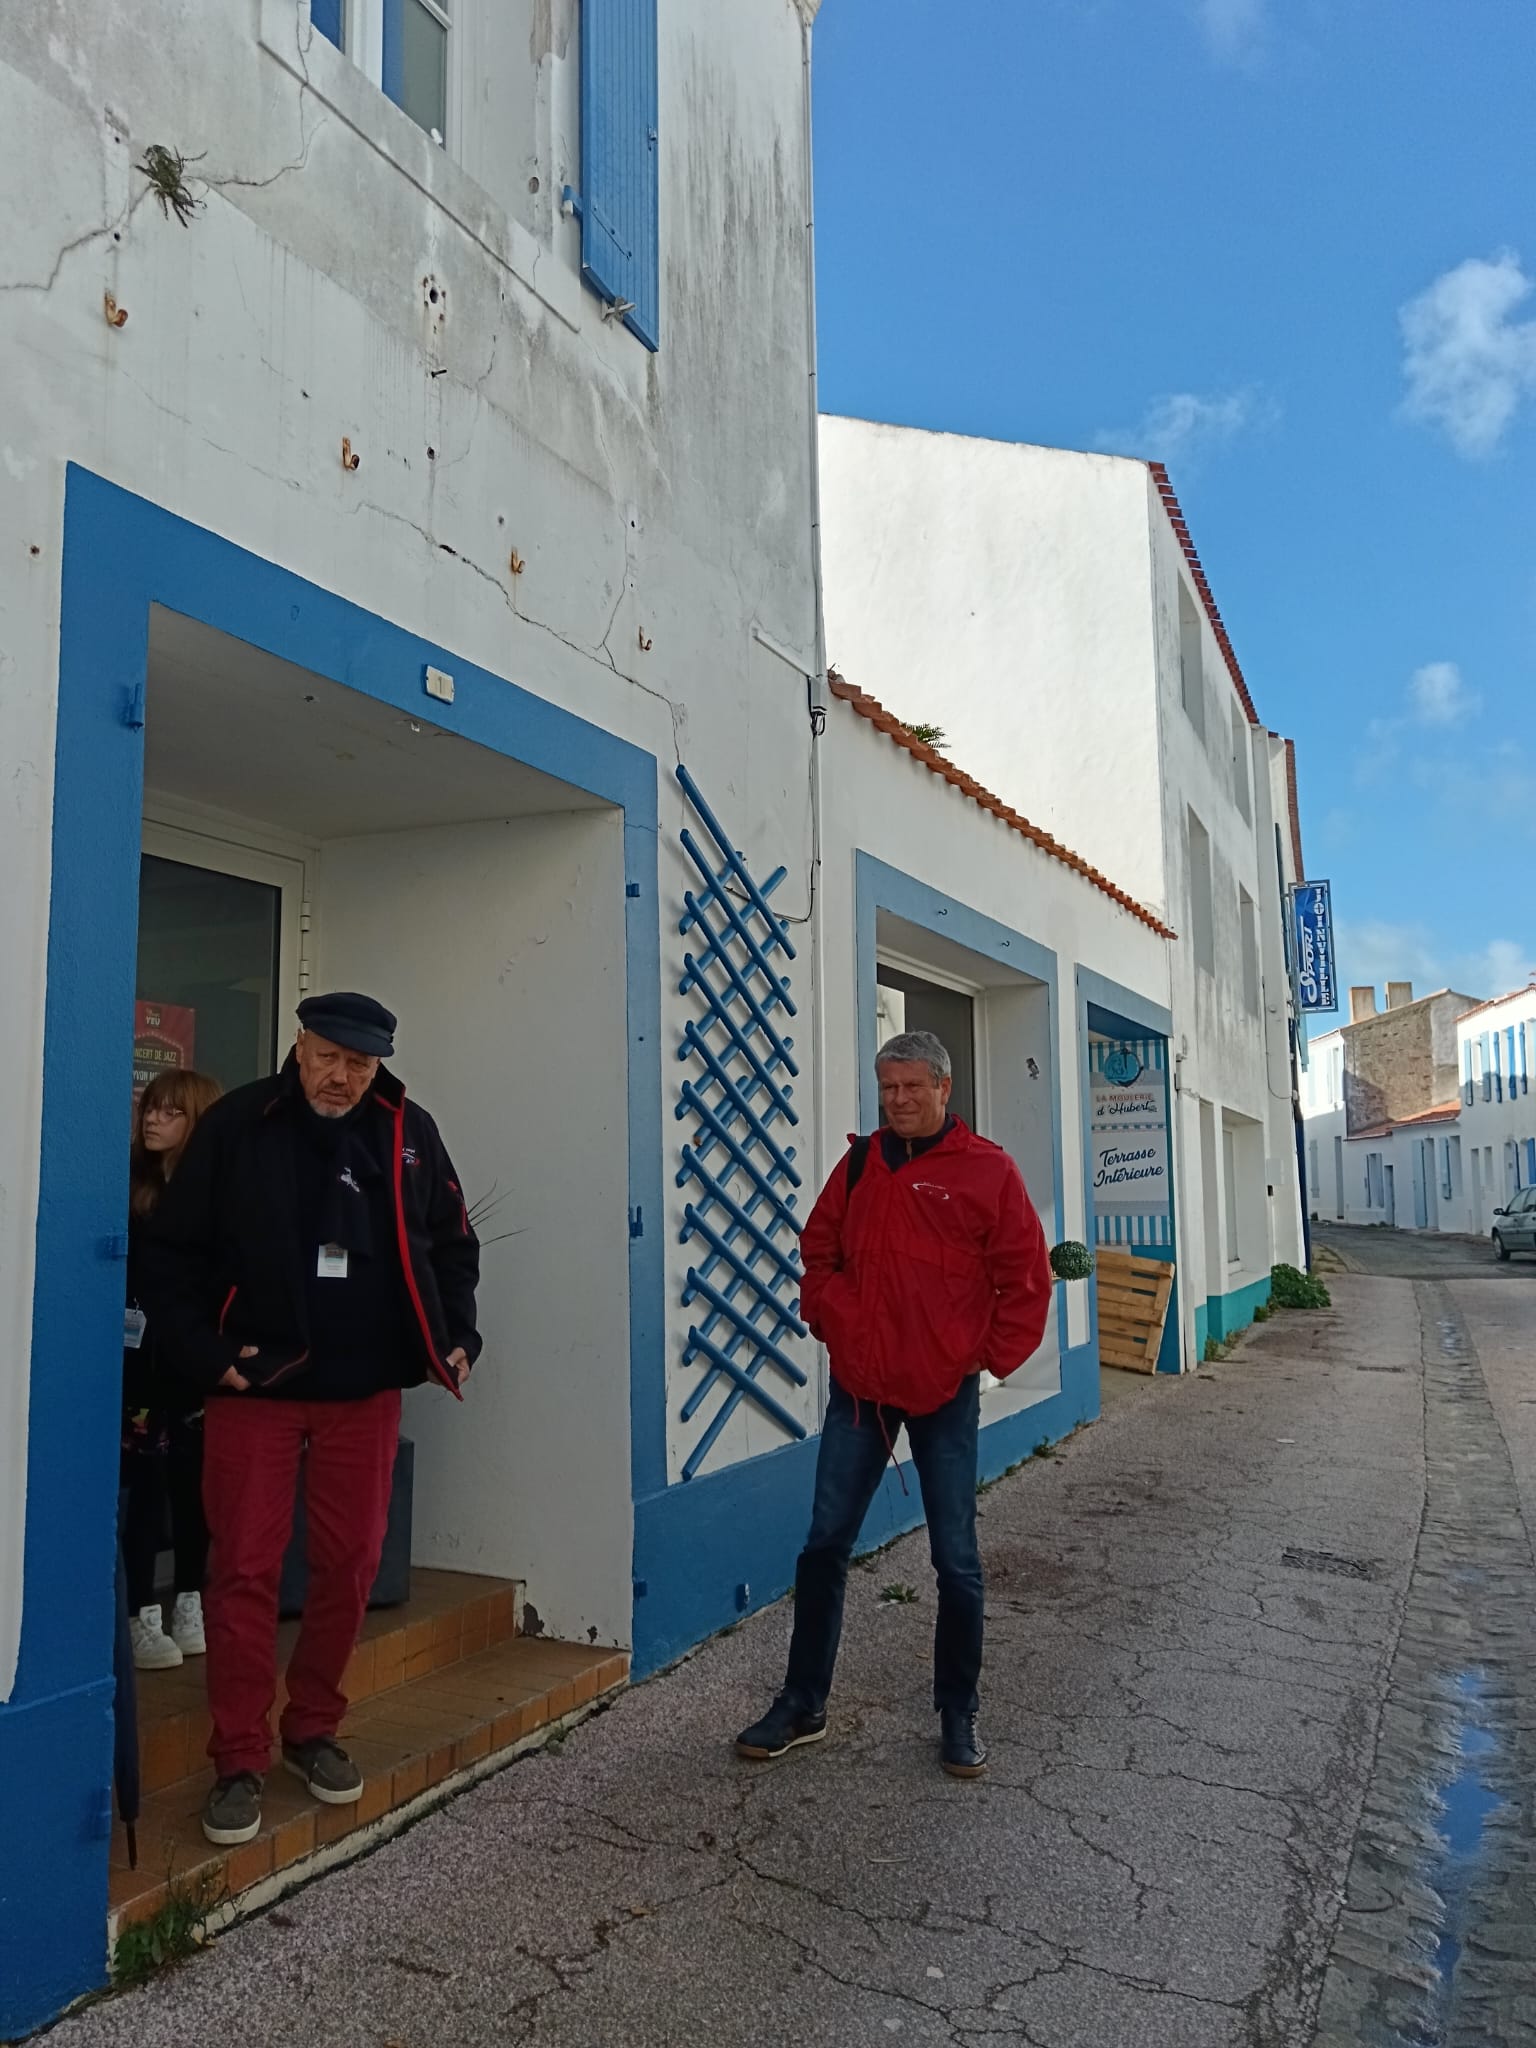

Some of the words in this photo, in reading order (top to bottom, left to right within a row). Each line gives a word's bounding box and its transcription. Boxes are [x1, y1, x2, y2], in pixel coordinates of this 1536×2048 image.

[1314, 888, 1332, 1006] JOINVILLE
[134, 1047, 152, 1059] NCERT
[1096, 1094, 1107, 1102] LA
[1109, 1092, 1153, 1102] MOULERIE
[1097, 1100, 1155, 1116] d'Hubert
[1099, 1147, 1156, 1167] Terrasse
[1093, 1165, 1164, 1188] Intérieure
